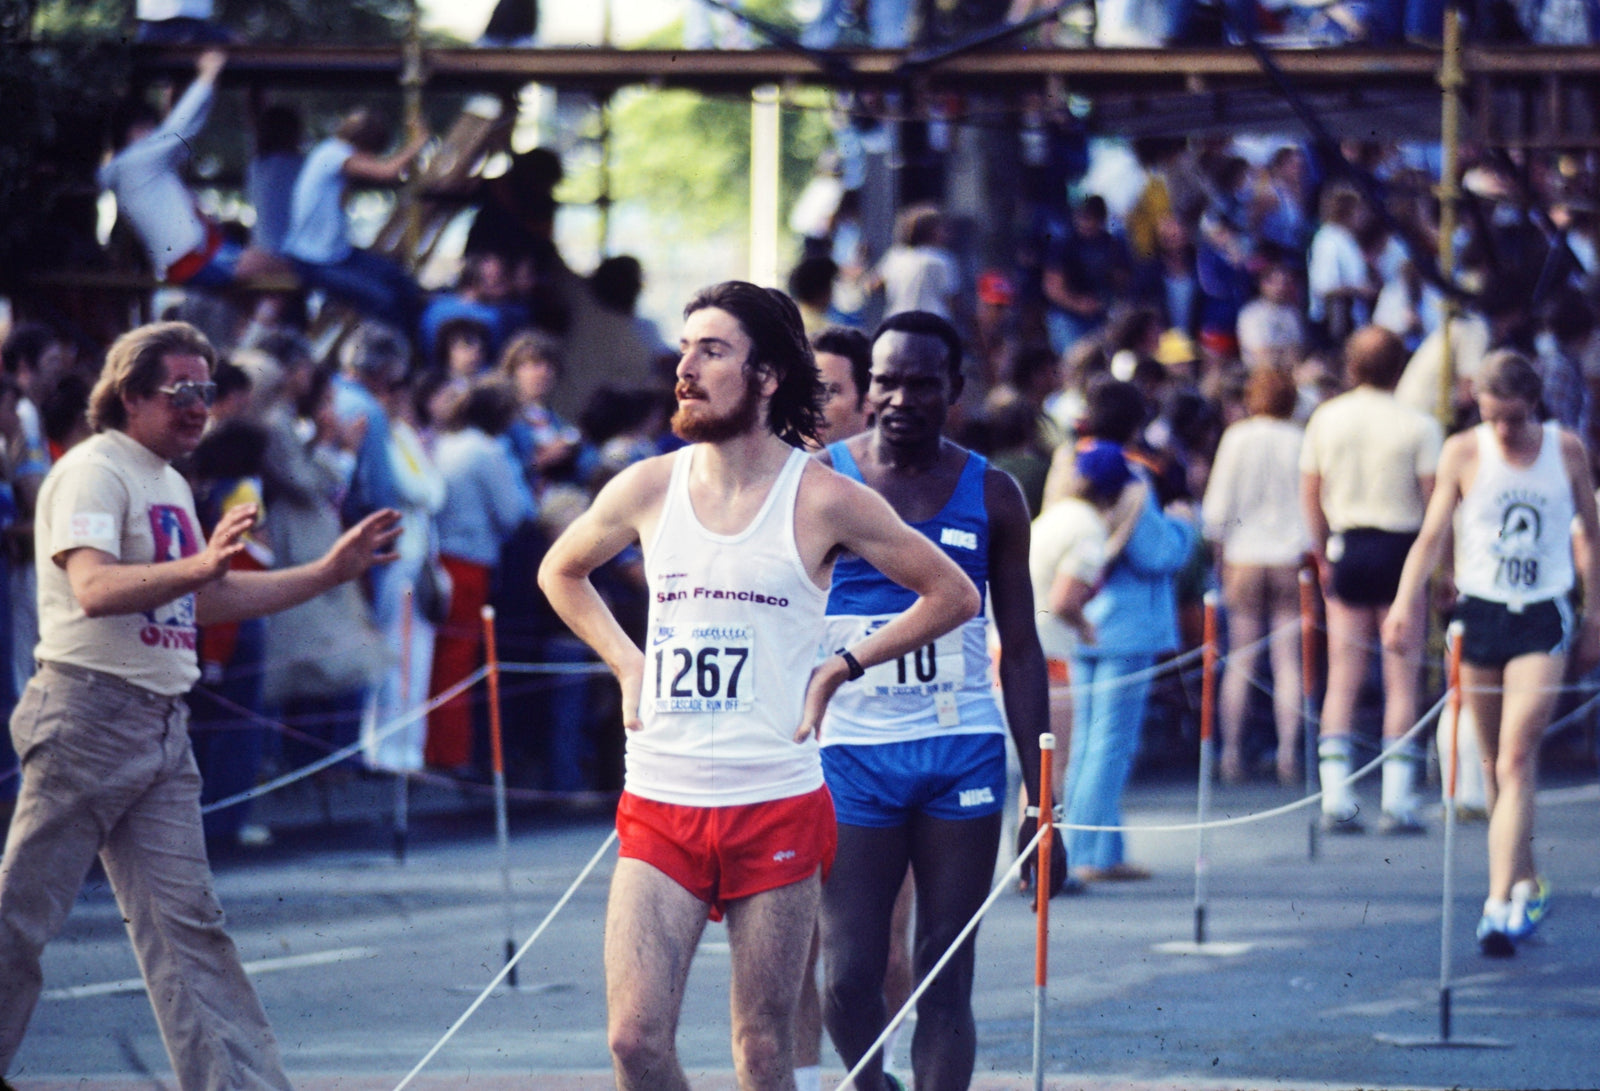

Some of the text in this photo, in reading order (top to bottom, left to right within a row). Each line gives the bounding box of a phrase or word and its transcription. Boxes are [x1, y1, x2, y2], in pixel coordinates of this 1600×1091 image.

[940, 528, 977, 550] NIKE
[1493, 557, 1538, 586] 708
[657, 587, 790, 607] San Francisco
[655, 647, 749, 698] 1267
[897, 641, 936, 684] 10
[671, 700, 702, 711] CASCADE
[706, 700, 721, 711] RUN
[725, 700, 738, 711] OFF
[959, 787, 995, 807] NIKE
